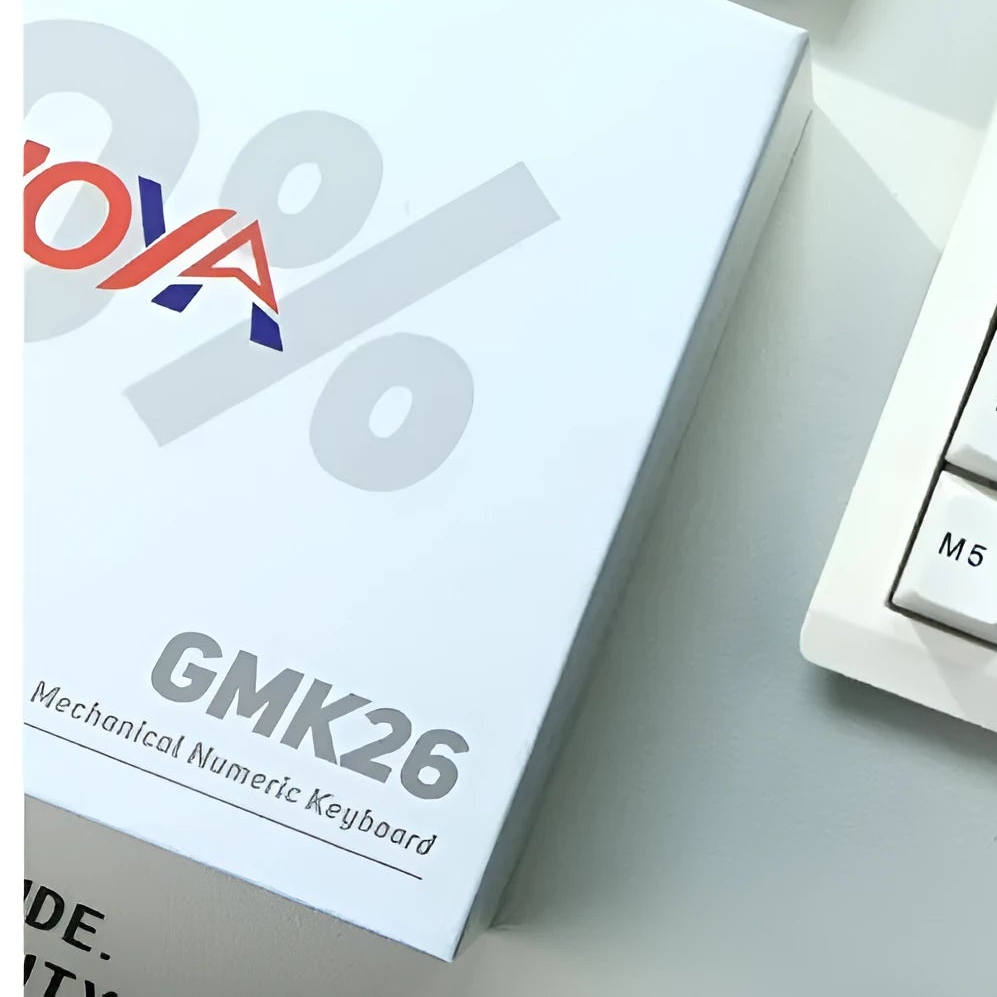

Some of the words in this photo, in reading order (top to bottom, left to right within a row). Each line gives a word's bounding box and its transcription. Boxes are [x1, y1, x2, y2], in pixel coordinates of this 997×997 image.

[24, 139, 283, 351] OYA
[939, 532, 987, 567] M5
[29, 679, 185, 759] Mechanical
[189, 742, 302, 804] Numeric
[305, 789, 438, 857] Keyboard
[150, 631, 470, 800] GMK26
